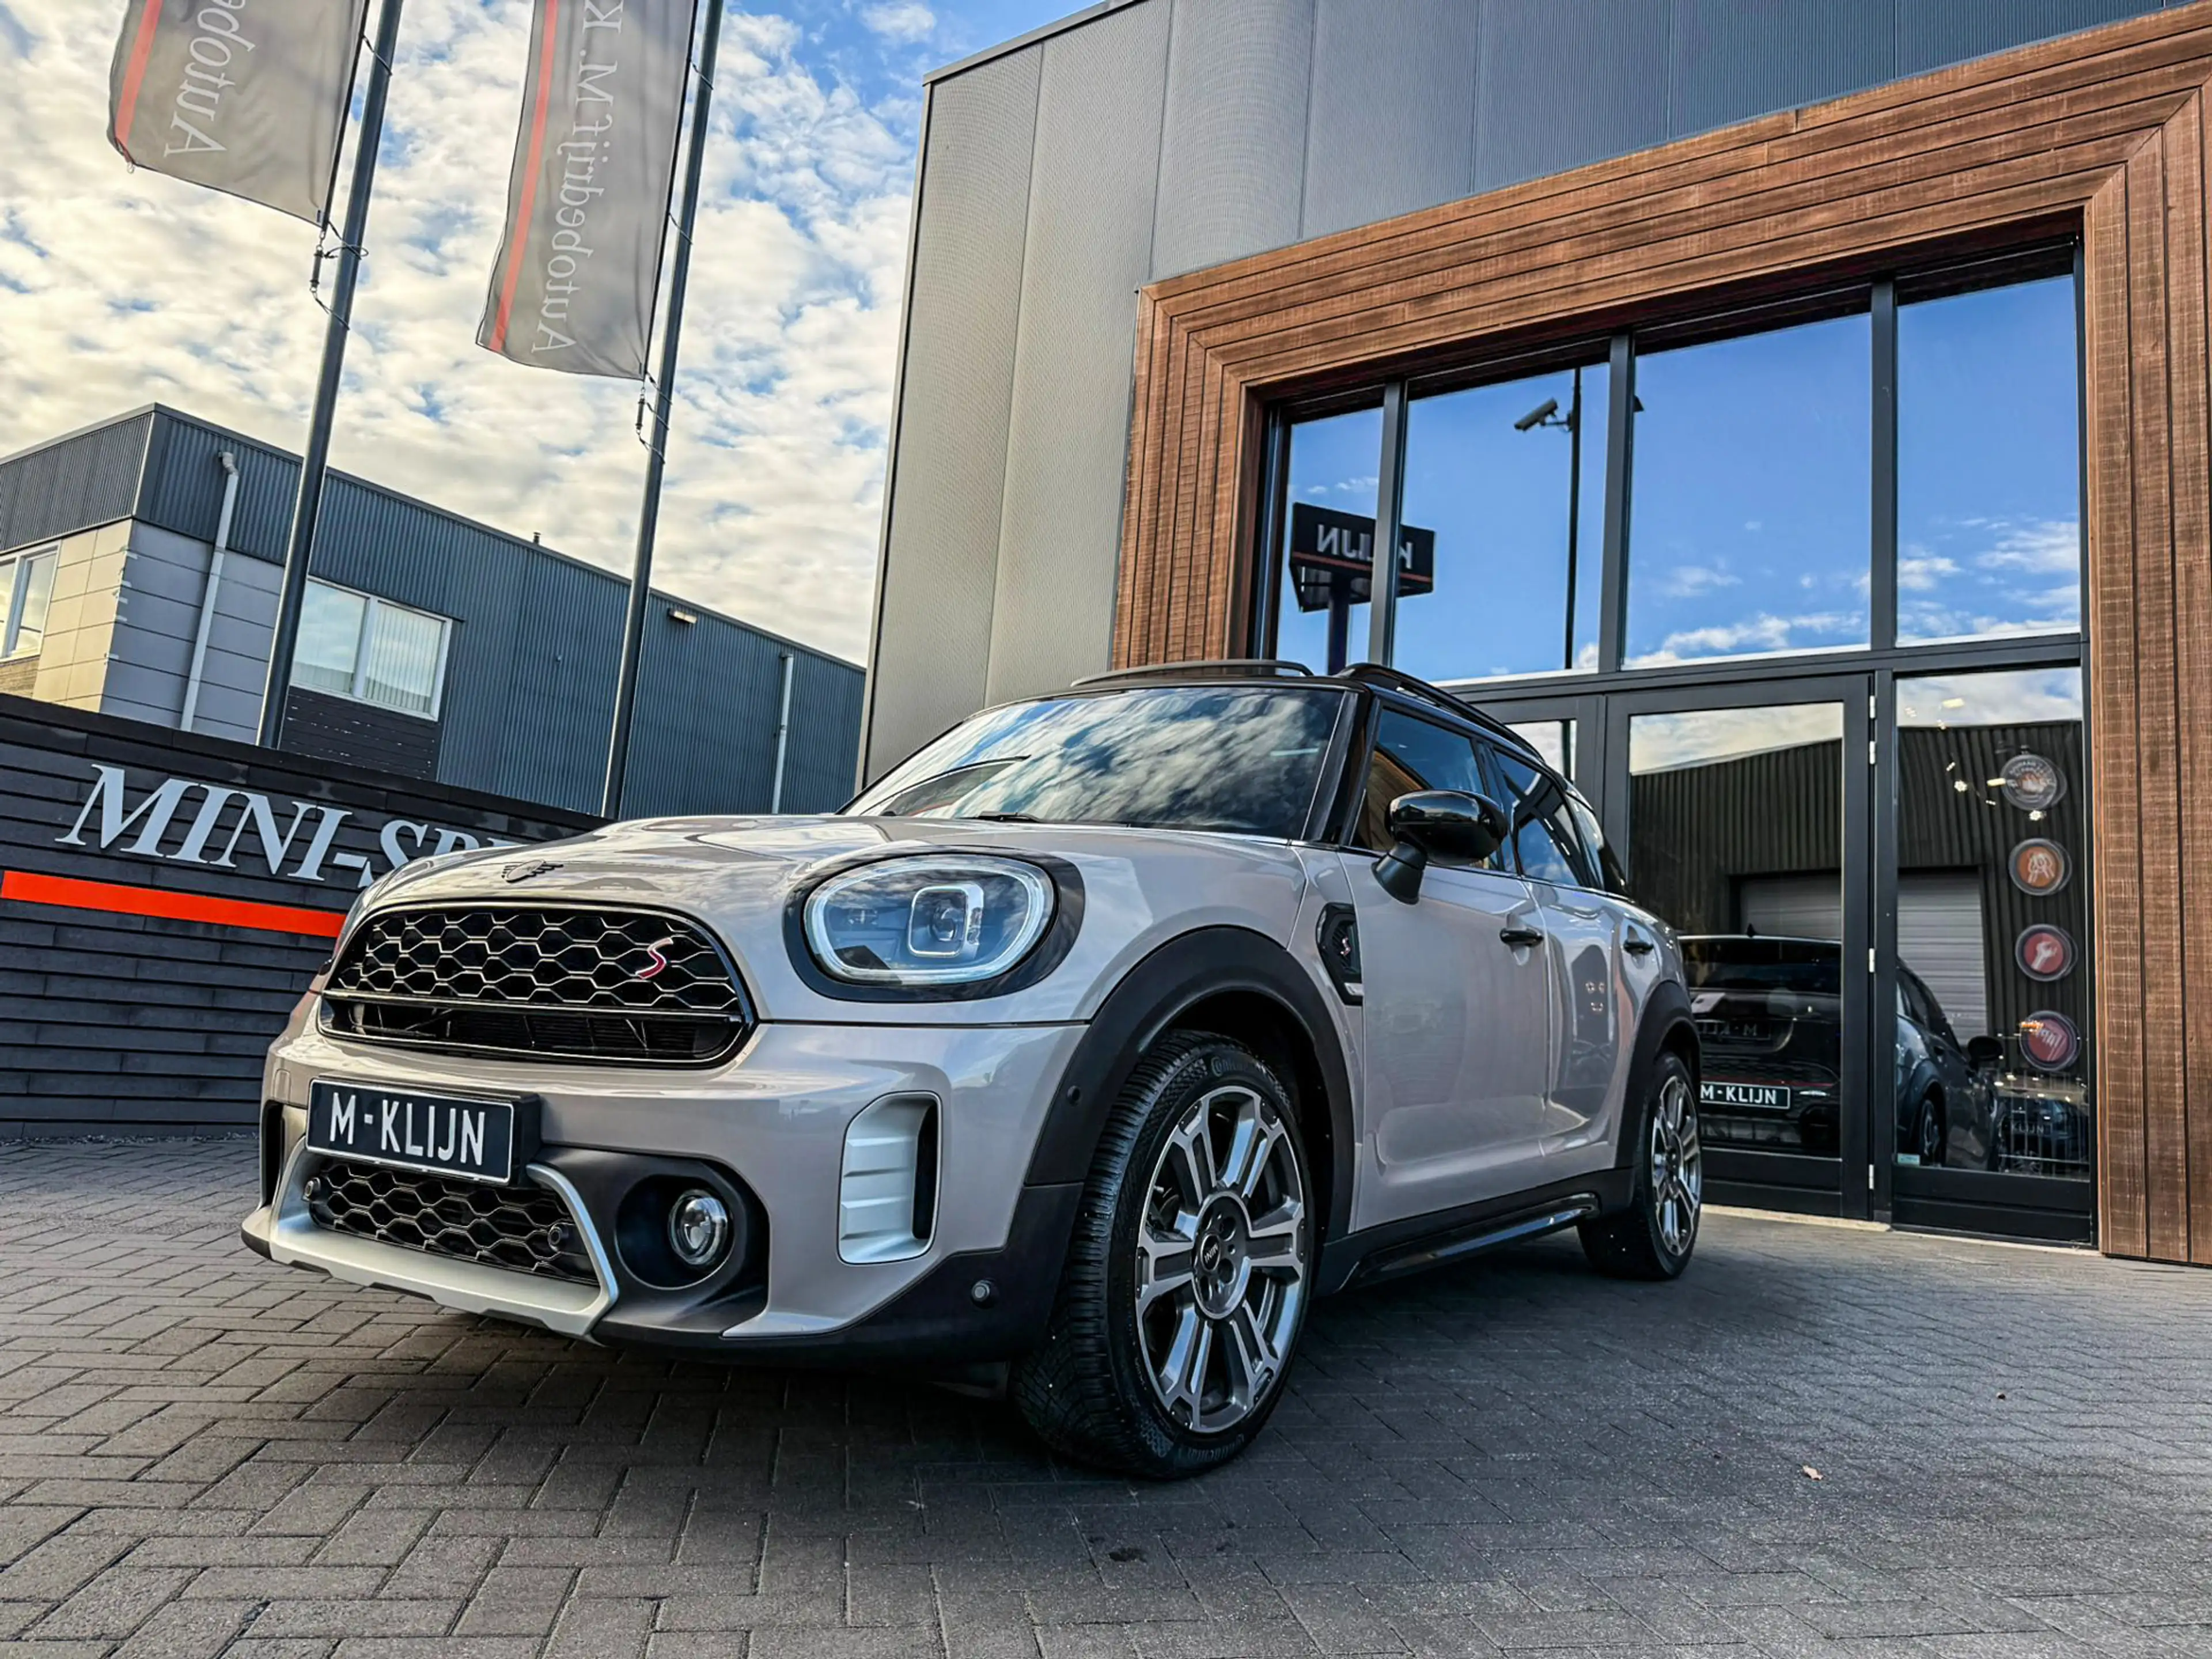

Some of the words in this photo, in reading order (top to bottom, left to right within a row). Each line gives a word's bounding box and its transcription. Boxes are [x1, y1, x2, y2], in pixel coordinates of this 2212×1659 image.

[55, 764, 527, 888] MINI-S
[635, 937, 673, 979] S
[1700, 1084, 1777, 1105] M-KLIJN
[329, 1092, 485, 1166] M-KLIJN
